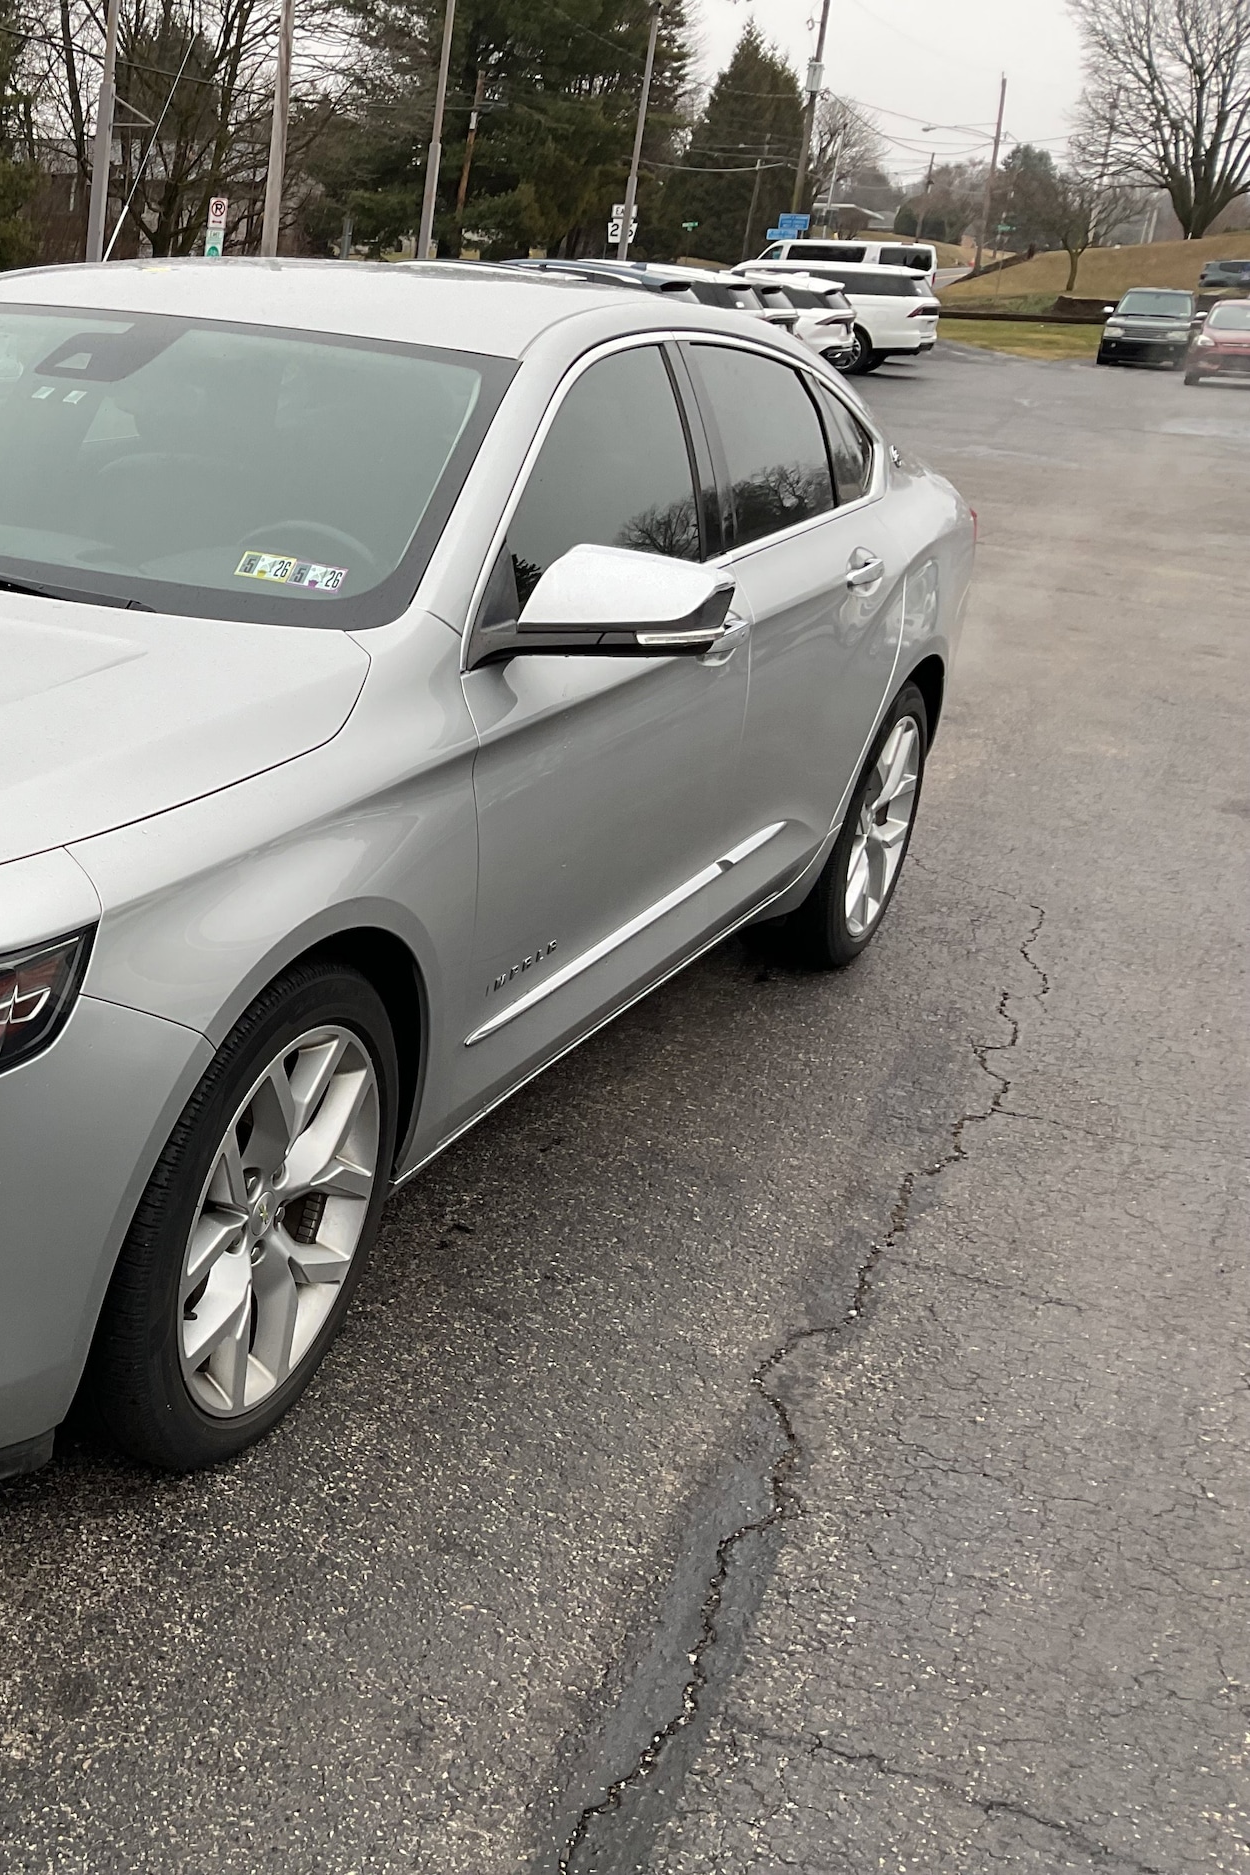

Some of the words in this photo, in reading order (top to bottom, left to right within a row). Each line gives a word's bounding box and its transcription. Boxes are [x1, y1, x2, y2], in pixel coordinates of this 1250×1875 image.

[244, 558, 257, 574] 5
[273, 560, 292, 578] 26
[293, 567, 307, 583] 5
[324, 570, 343, 589] 26
[485, 939, 557, 997] IMPALA
